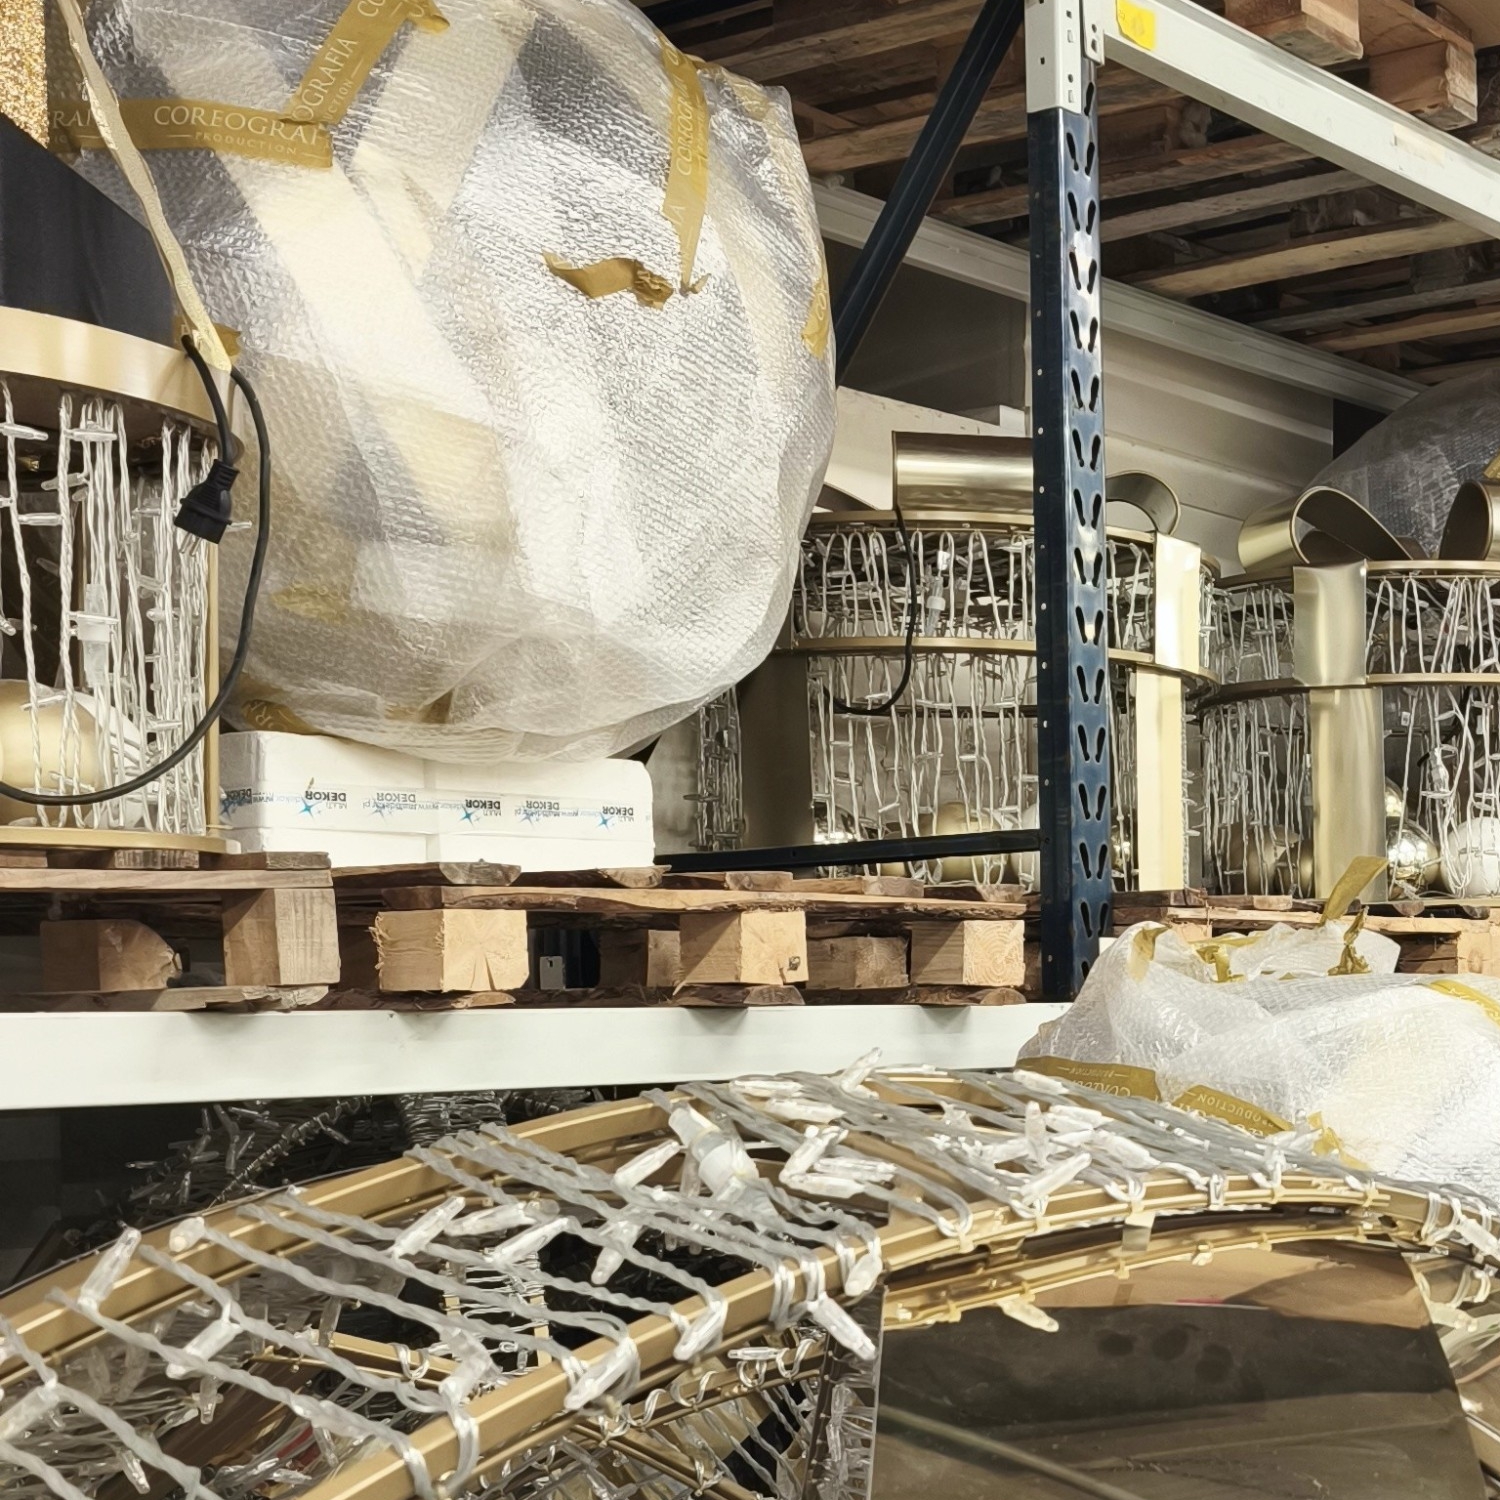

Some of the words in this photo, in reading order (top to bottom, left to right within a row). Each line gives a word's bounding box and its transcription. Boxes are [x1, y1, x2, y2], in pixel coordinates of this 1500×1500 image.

[195, 131, 298, 155] PRODUCTION
[305, 790, 346, 802] DEKOR
[376, 792, 416, 803] DEKOR
[465, 799, 501, 810] DEKOR
[525, 800, 560, 811] DEKOR
[602, 805, 634, 816] DEKOR
